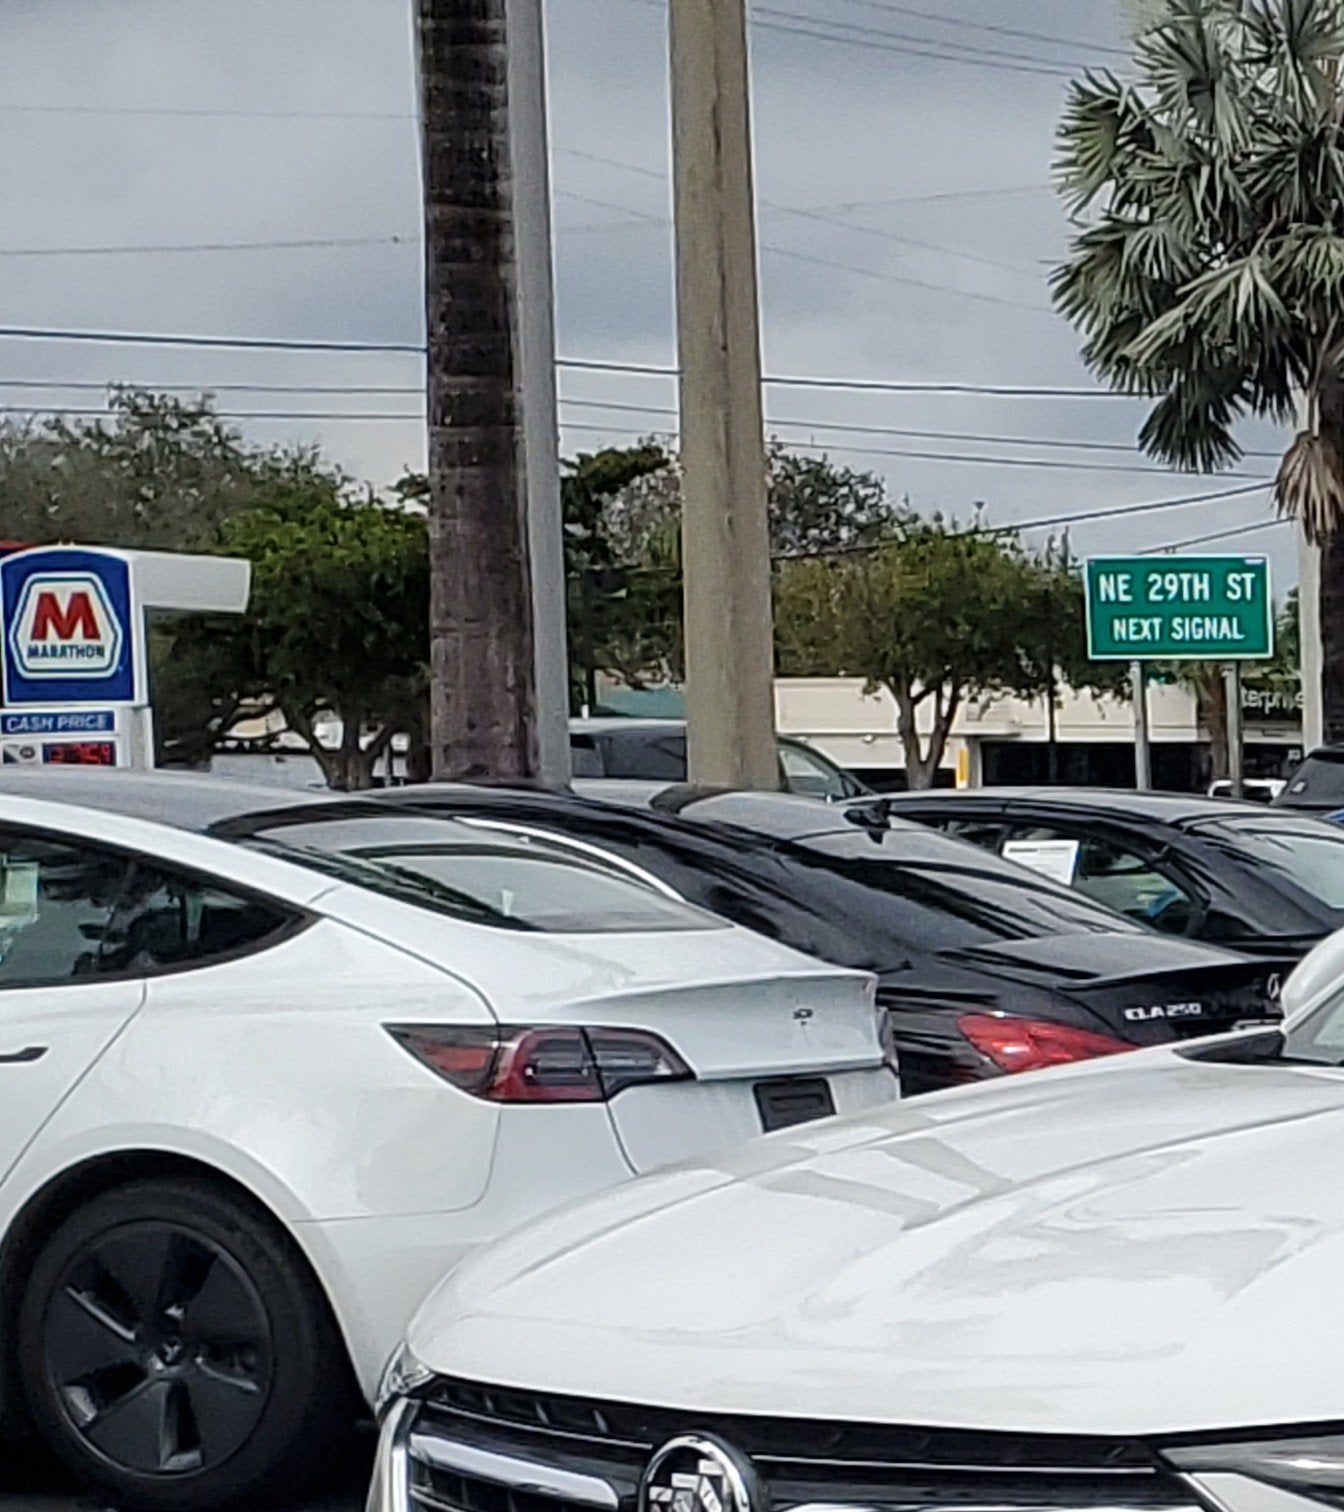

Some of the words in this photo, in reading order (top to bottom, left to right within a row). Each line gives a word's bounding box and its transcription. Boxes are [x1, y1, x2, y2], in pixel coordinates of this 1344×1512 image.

[1099, 573, 1133, 602] NE
[1147, 573, 1210, 601] 29TH
[1226, 573, 1256, 600] ST
[30, 591, 101, 641] M
[1113, 617, 1163, 641] NEXT
[1170, 617, 1246, 641] SIGNAL
[27, 645, 105, 659] MARATHON
[6, 716, 53, 732] CASH
[57, 714, 108, 729] PRICE
